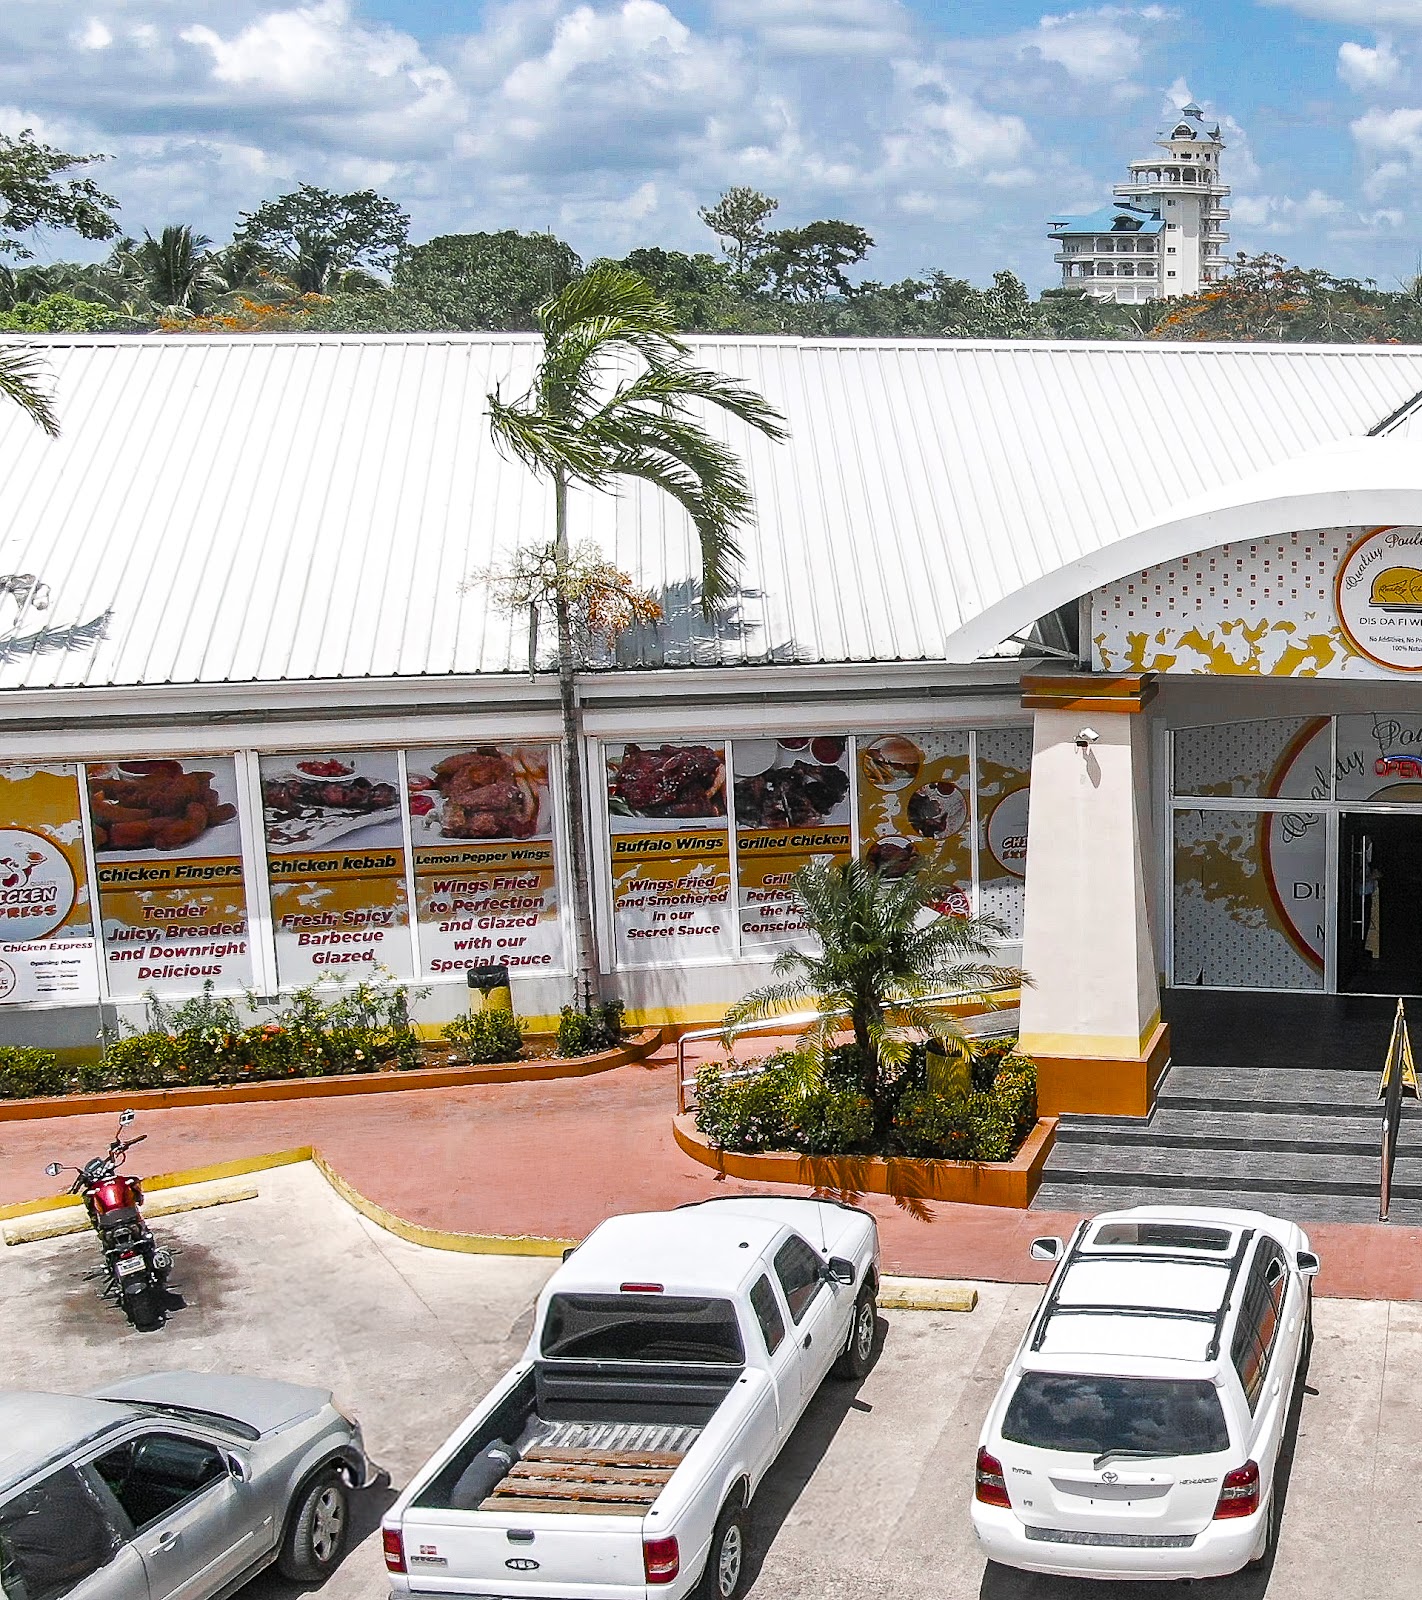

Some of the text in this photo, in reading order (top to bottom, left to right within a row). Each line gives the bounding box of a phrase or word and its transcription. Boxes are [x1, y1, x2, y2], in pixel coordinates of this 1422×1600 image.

[1346, 547, 1383, 591] Quality
[1359, 617, 1377, 625] DIS
[1380, 618, 1396, 626] DA
[1398, 618, 1407, 626] FI
[1409, 618, 1422, 626] WI
[615, 837, 724, 853] Buffalo Wings
[738, 833, 849, 850] Grilled Chicken
[269, 855, 397, 874] Chicken kebab
[416, 849, 551, 865] Lemon Pepper Wings
[99, 865, 242, 882] Chicken Fingers
[433, 876, 540, 894] Wings Fried
[628, 876, 716, 892] Wings Fried
[429, 896, 545, 913] to Perfection
[616, 891, 729, 908] and Smothered
[142, 904, 208, 920] Tender
[281, 909, 394, 927] Fresh, Spicy
[669, 910, 695, 921] our
[760, 905, 783, 917] the
[107, 921, 246, 943] Juicy, Breaded
[439, 914, 538, 933] and Glazed
[626, 925, 721, 938] Secret Sauce
[297, 931, 384, 946] Barbecue
[454, 936, 527, 951] with our
[3, 942, 93, 953] Chicken Express
[109, 941, 247, 962] and Downright
[311, 948, 375, 965] Glazed
[430, 953, 552, 973] Special Sauce
[137, 963, 222, 979] Delicious
